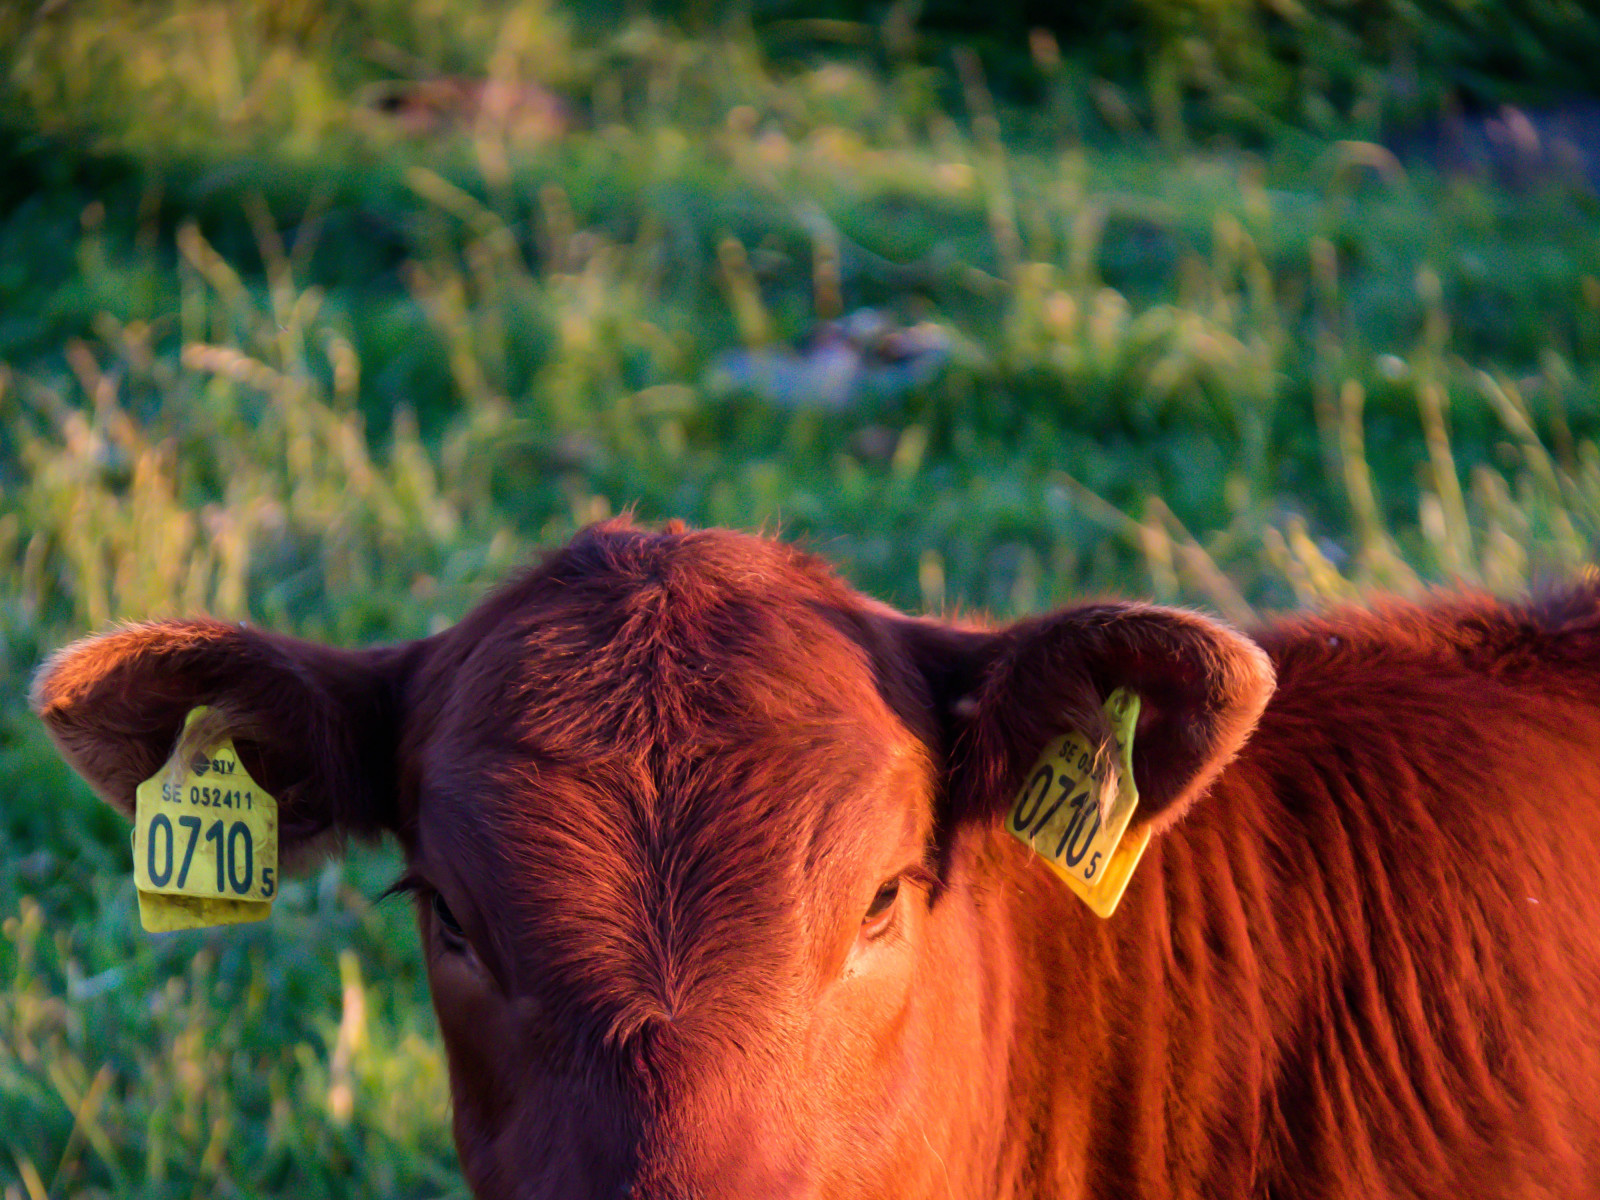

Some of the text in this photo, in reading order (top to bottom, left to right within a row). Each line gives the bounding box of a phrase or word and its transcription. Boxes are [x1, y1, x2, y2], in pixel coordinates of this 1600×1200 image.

[1059, 740, 1078, 763] SE
[162, 784, 252, 809] SE 052411
[1014, 765, 1101, 867] 0710
[1084, 852, 1101, 879] 5
[148, 813, 274, 897] 0710 5
